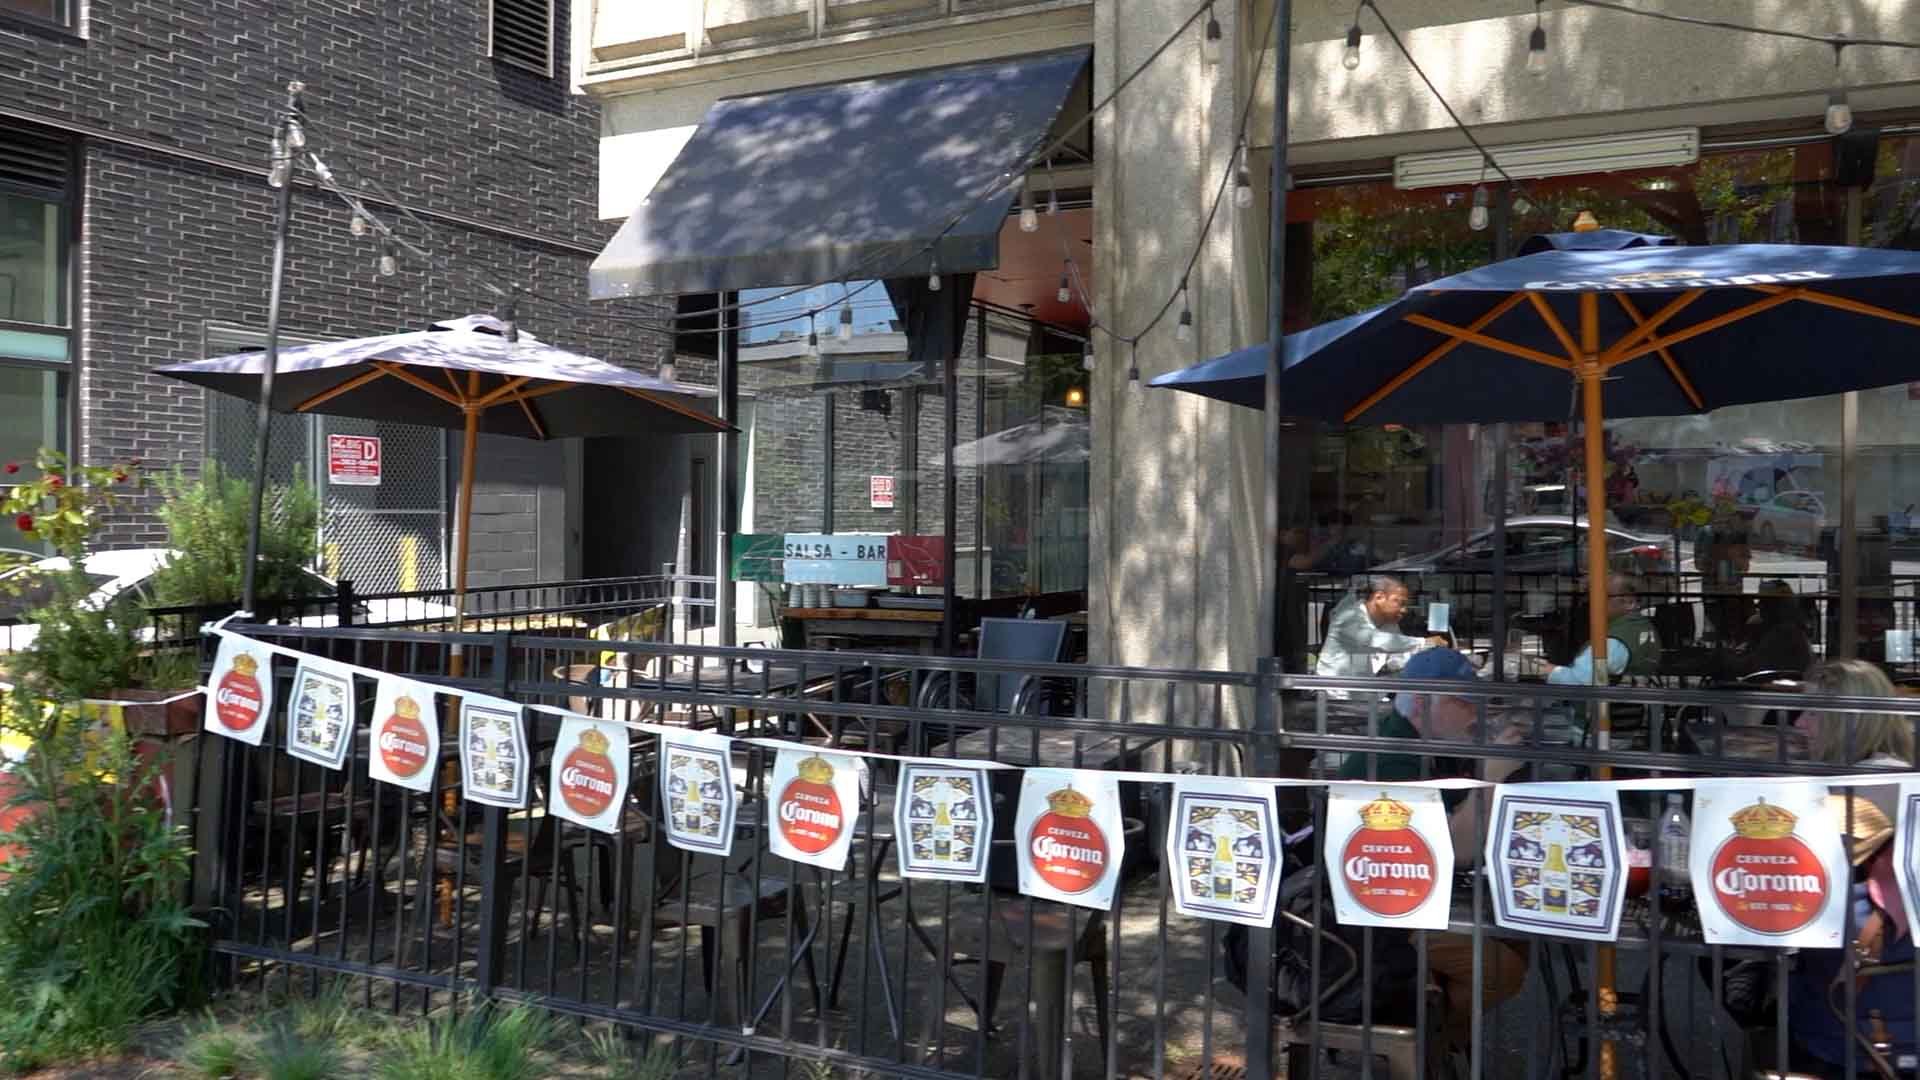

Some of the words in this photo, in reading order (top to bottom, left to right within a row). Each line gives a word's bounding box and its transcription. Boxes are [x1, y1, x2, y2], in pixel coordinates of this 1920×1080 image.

[785, 543, 832, 559] SALSA
[857, 544, 886, 560] BAR
[562, 766, 612, 797] Corona
[781, 800, 839, 829] Corona
[1047, 827, 1089, 840] CERVEZA
[1032, 835, 1103, 864] Corona
[1361, 845, 1413, 854] CERVEZA
[1736, 855, 1798, 864] CERVEZA
[1345, 856, 1432, 884] Corona
[1716, 866, 1823, 897] Corona
